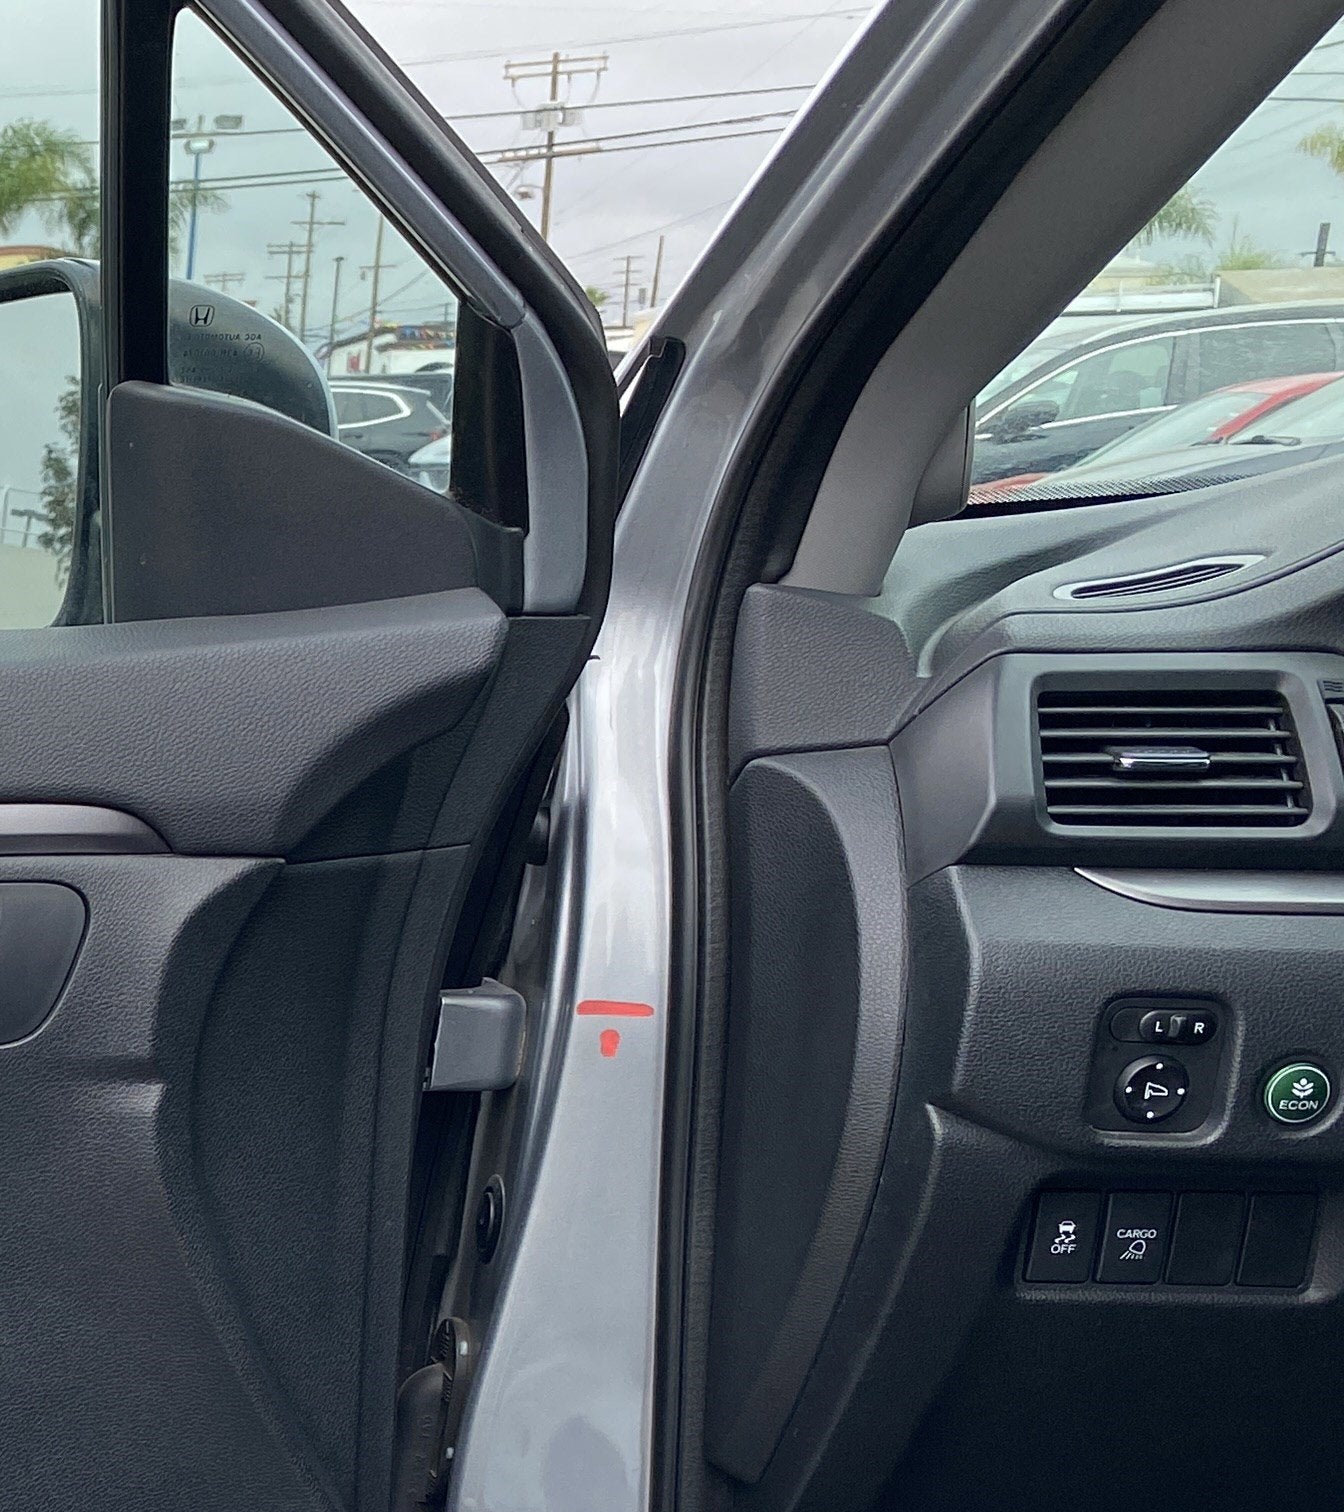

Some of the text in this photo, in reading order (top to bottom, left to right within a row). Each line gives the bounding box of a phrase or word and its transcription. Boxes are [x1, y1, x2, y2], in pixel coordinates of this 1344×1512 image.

[1155, 1021, 1205, 1034] L R
[1278, 1099, 1319, 1111] ECON
[1116, 1229, 1157, 1239] CARGO
[1050, 1243, 1077, 1254] OFF
